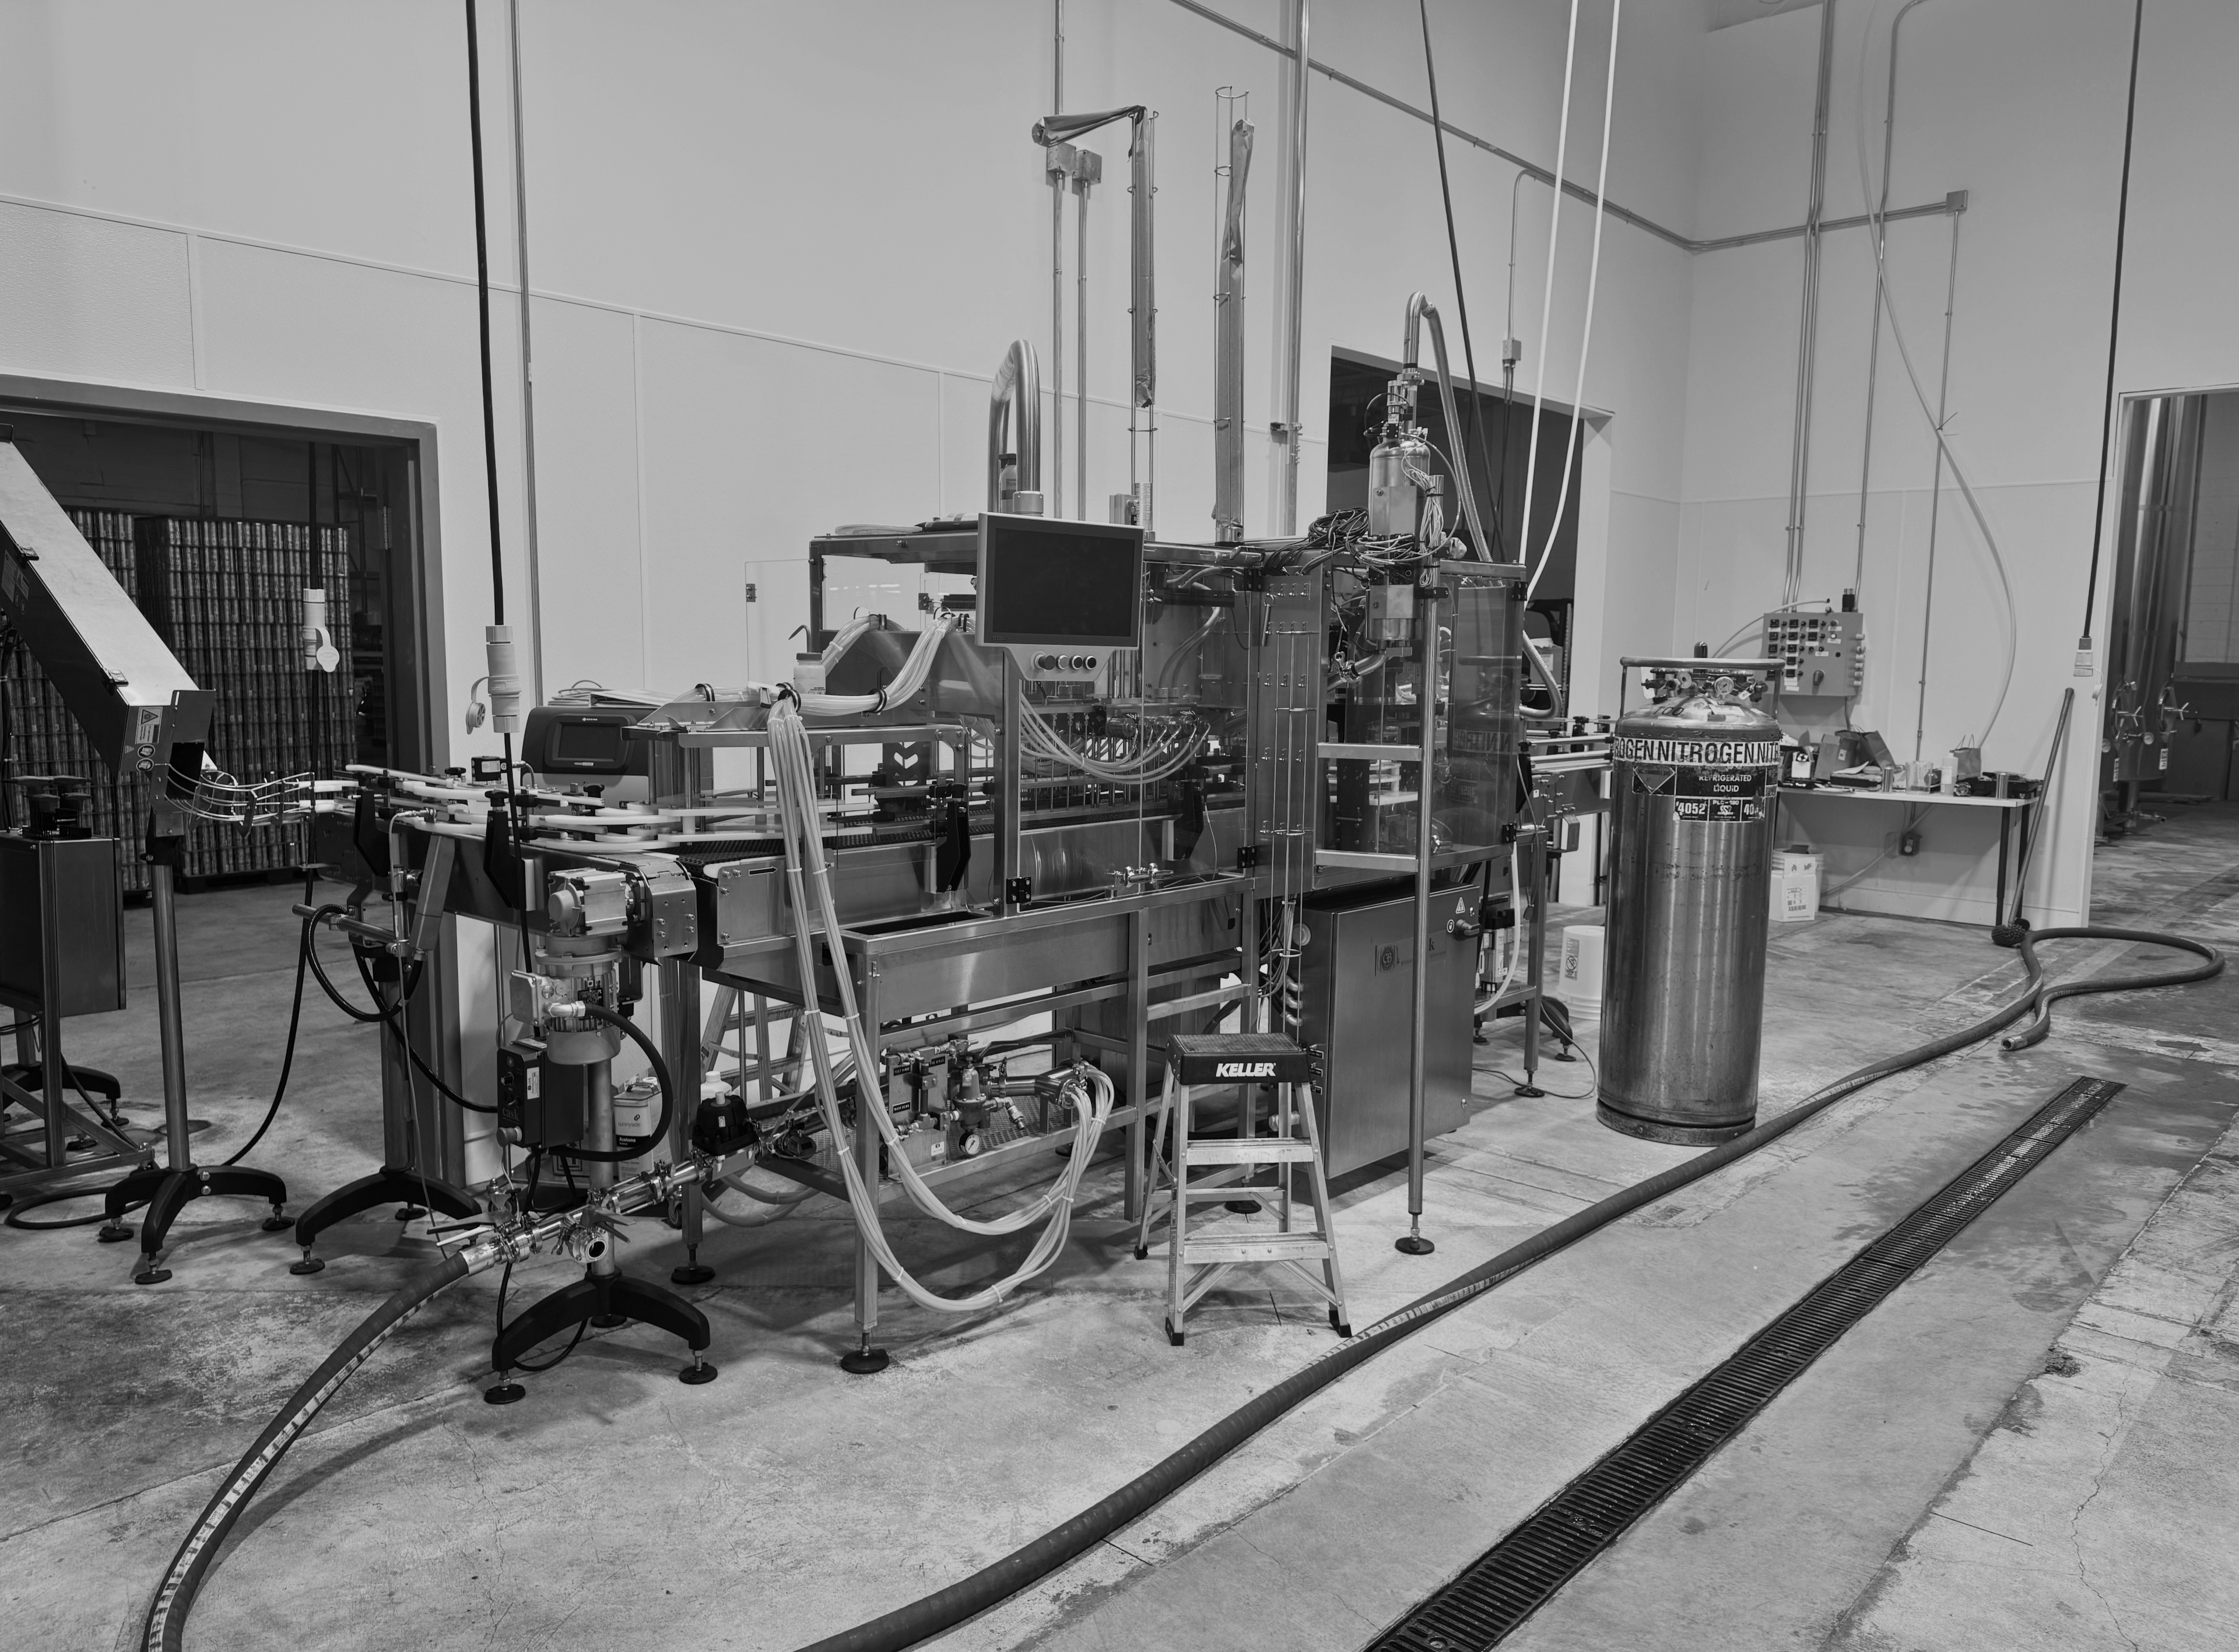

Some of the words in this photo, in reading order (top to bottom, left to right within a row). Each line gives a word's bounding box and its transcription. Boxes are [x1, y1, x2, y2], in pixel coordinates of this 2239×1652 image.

[1658, 740, 1754, 764] NITROGEN
[1713, 784, 1739, 792] LIQUID
[1678, 802, 1705, 814] 4052
[1215, 1063, 1276, 1077] KELLER
[502, 1108, 520, 1121] cask
